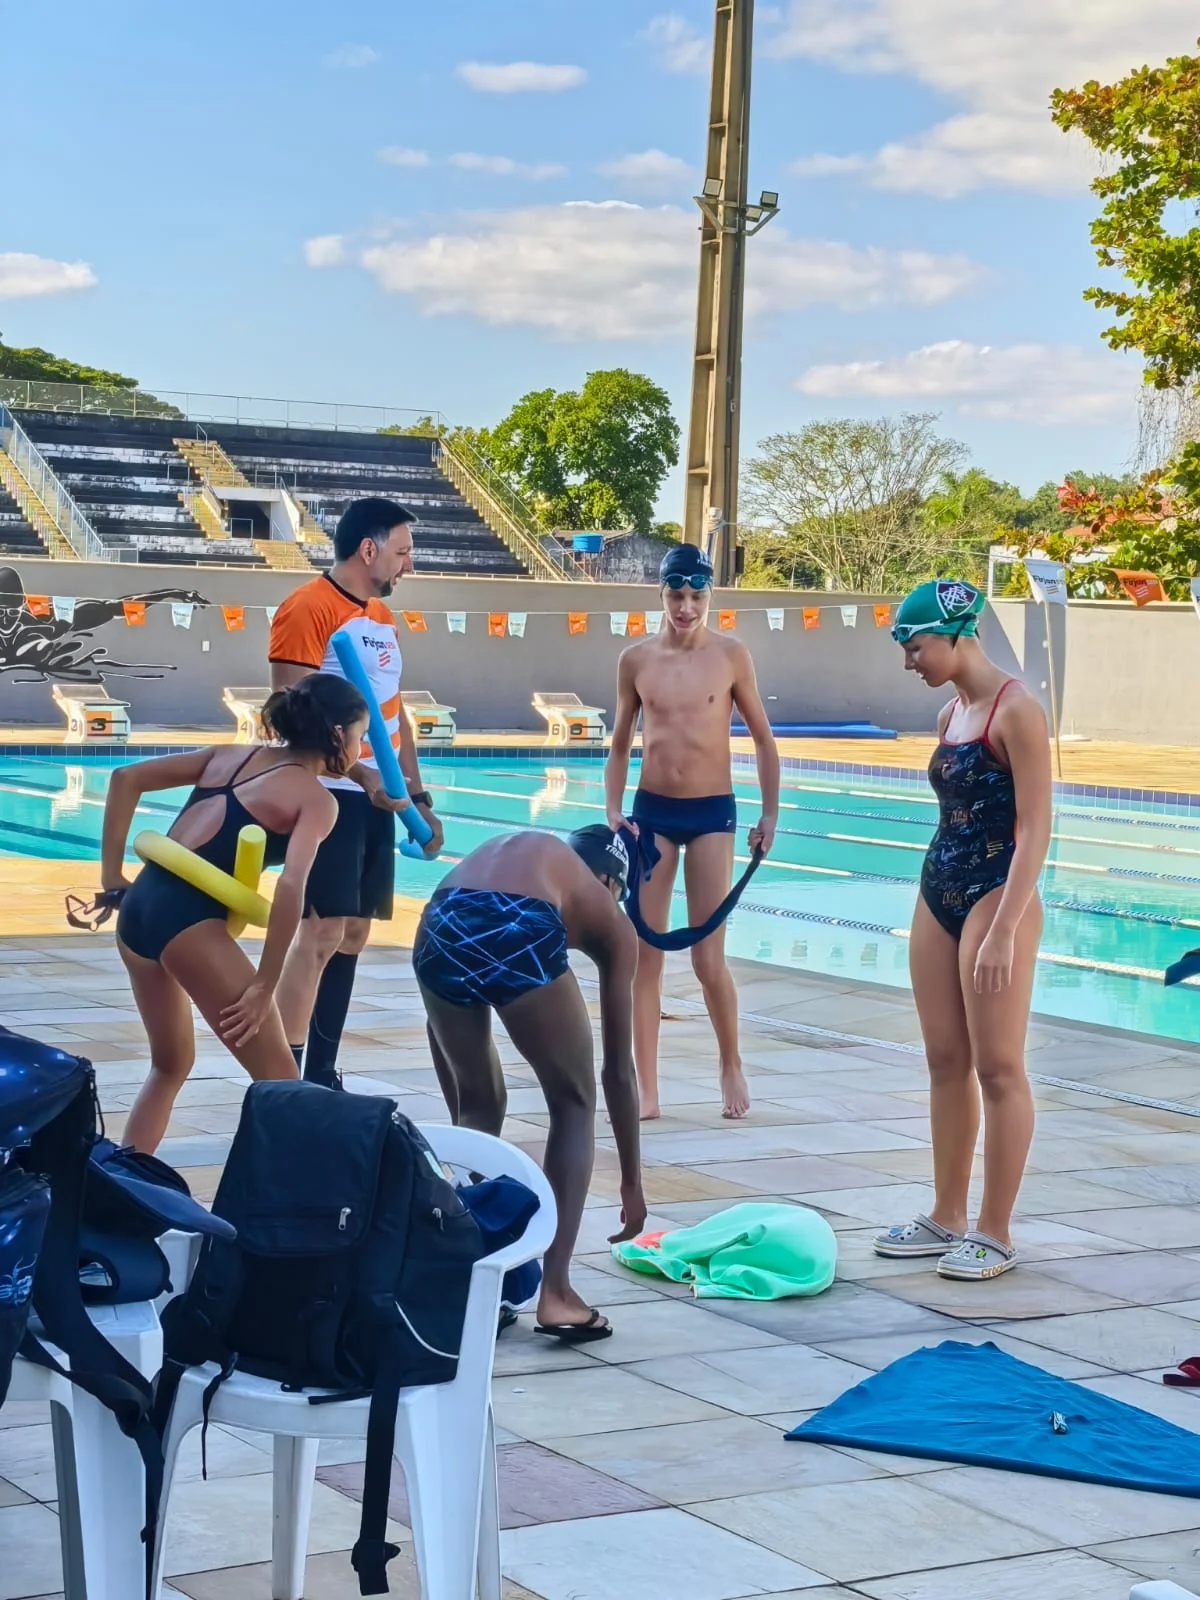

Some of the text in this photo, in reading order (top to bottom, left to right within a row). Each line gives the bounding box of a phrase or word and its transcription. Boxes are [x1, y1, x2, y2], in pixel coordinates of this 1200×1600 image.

[91, 718, 107, 731] 3
[240, 720, 248, 732] 4
[552, 723, 561, 736] 6
